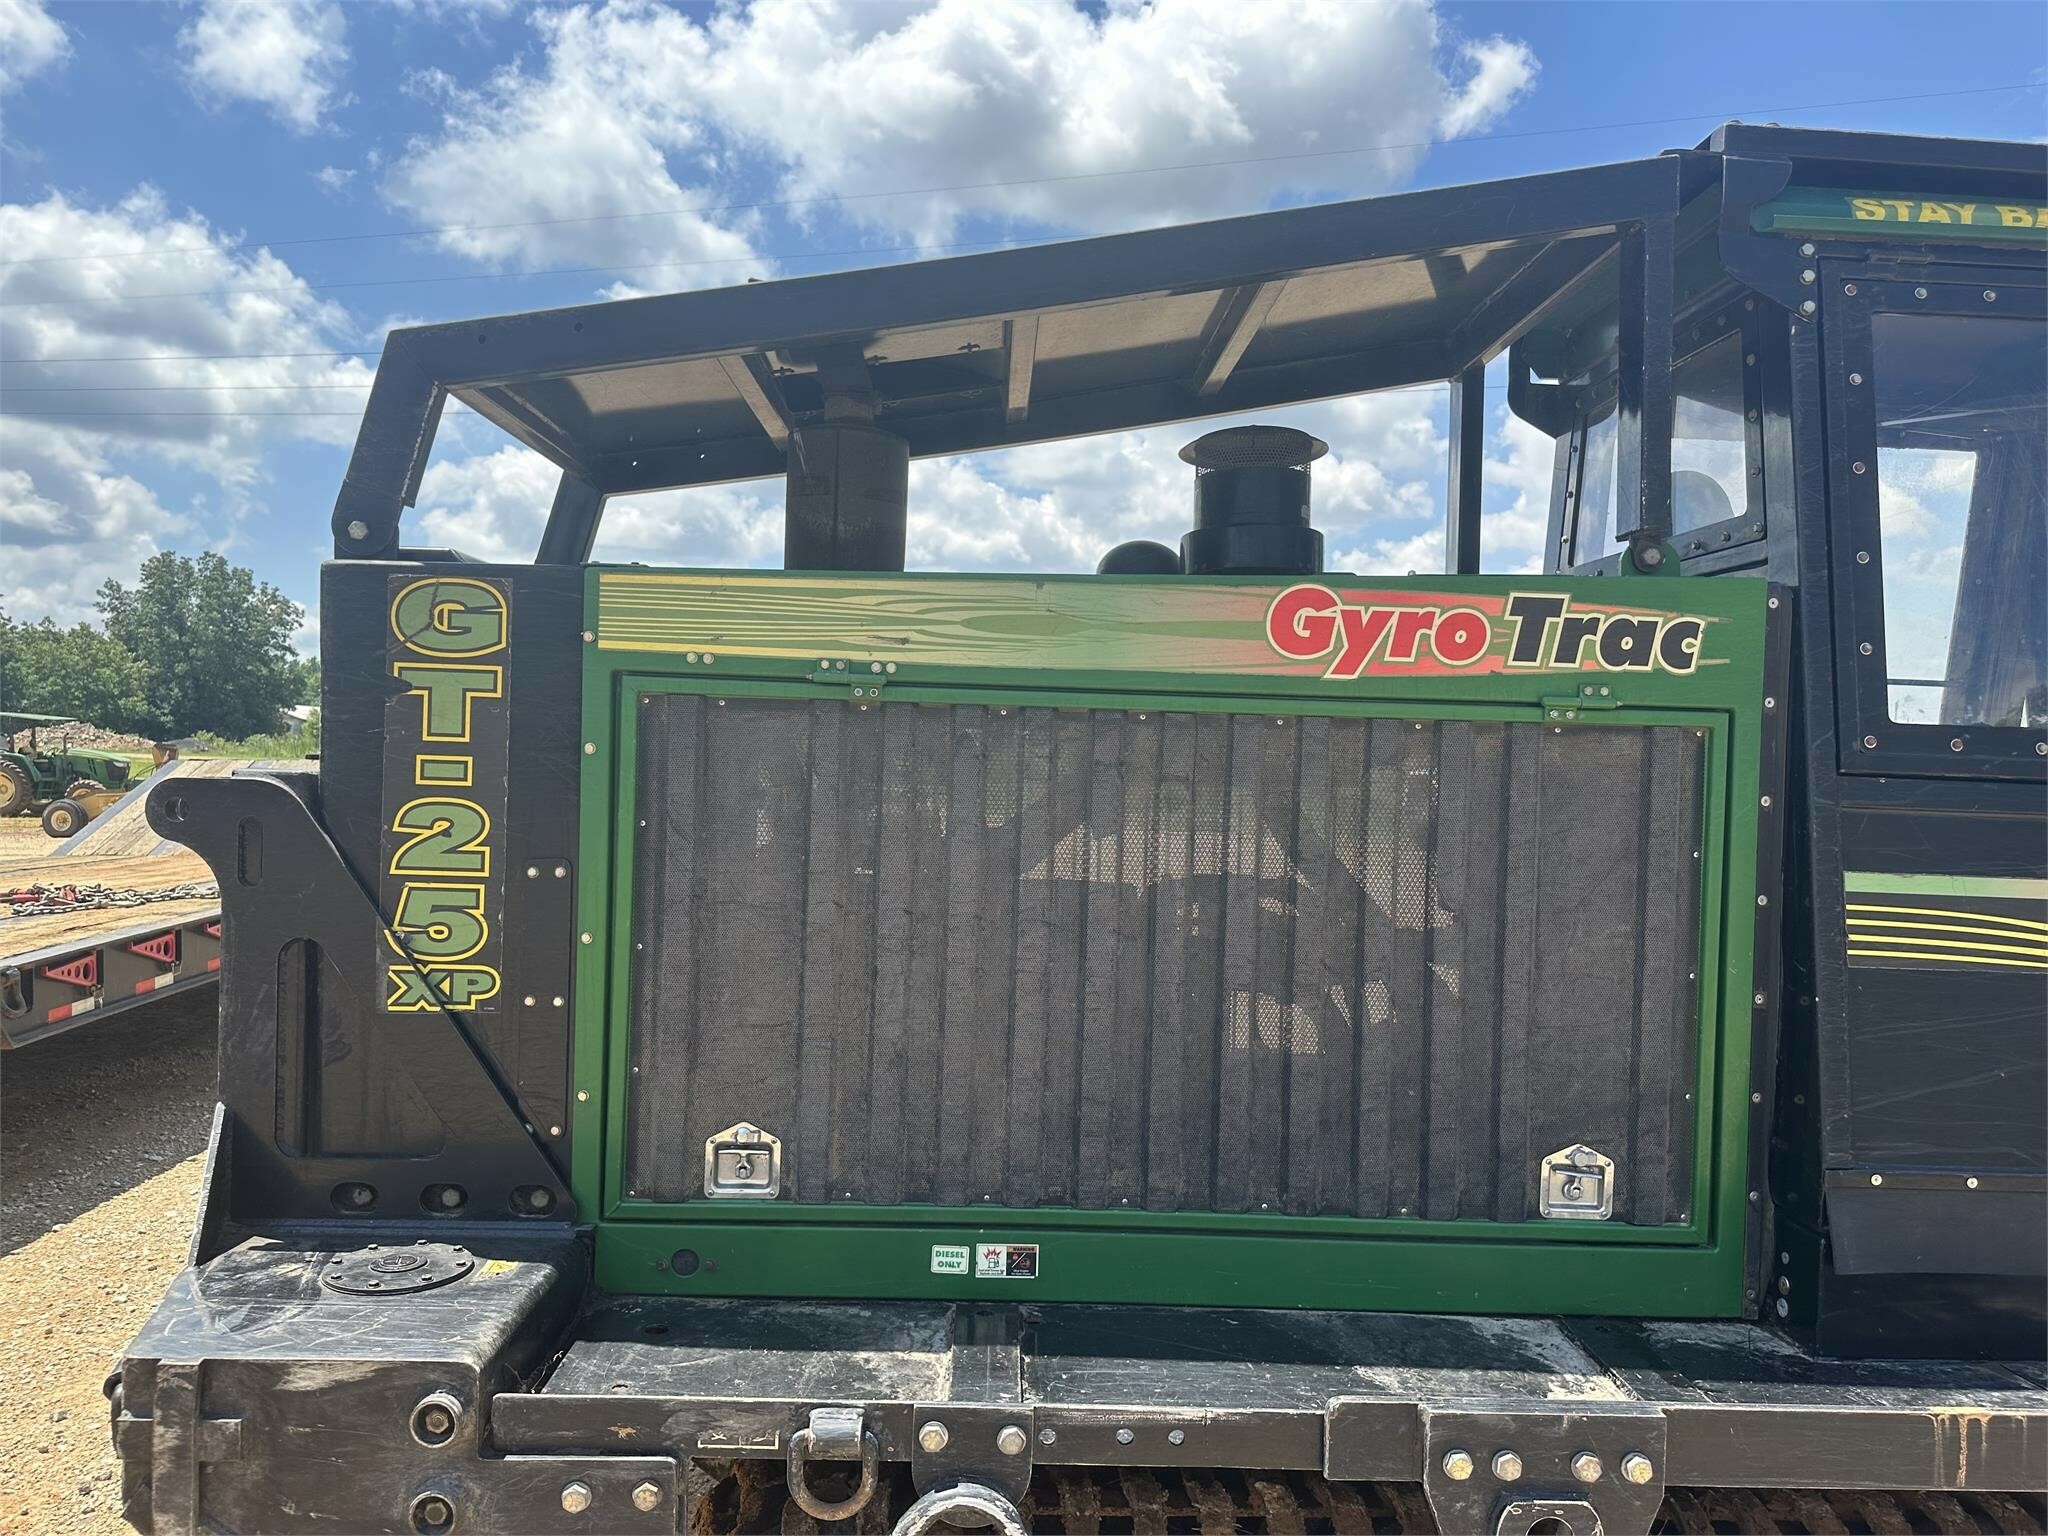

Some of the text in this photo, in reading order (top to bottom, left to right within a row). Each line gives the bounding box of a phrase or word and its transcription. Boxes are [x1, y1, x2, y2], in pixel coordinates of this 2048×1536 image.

[1851, 199, 1976, 225] STAY
[1266, 583, 1706, 680] Gyro Trac
[383, 577, 507, 962] GT-25
[387, 963, 502, 1012] XP
[935, 1250, 965, 1259] DIESEL
[937, 1260, 962, 1269] ONLY
